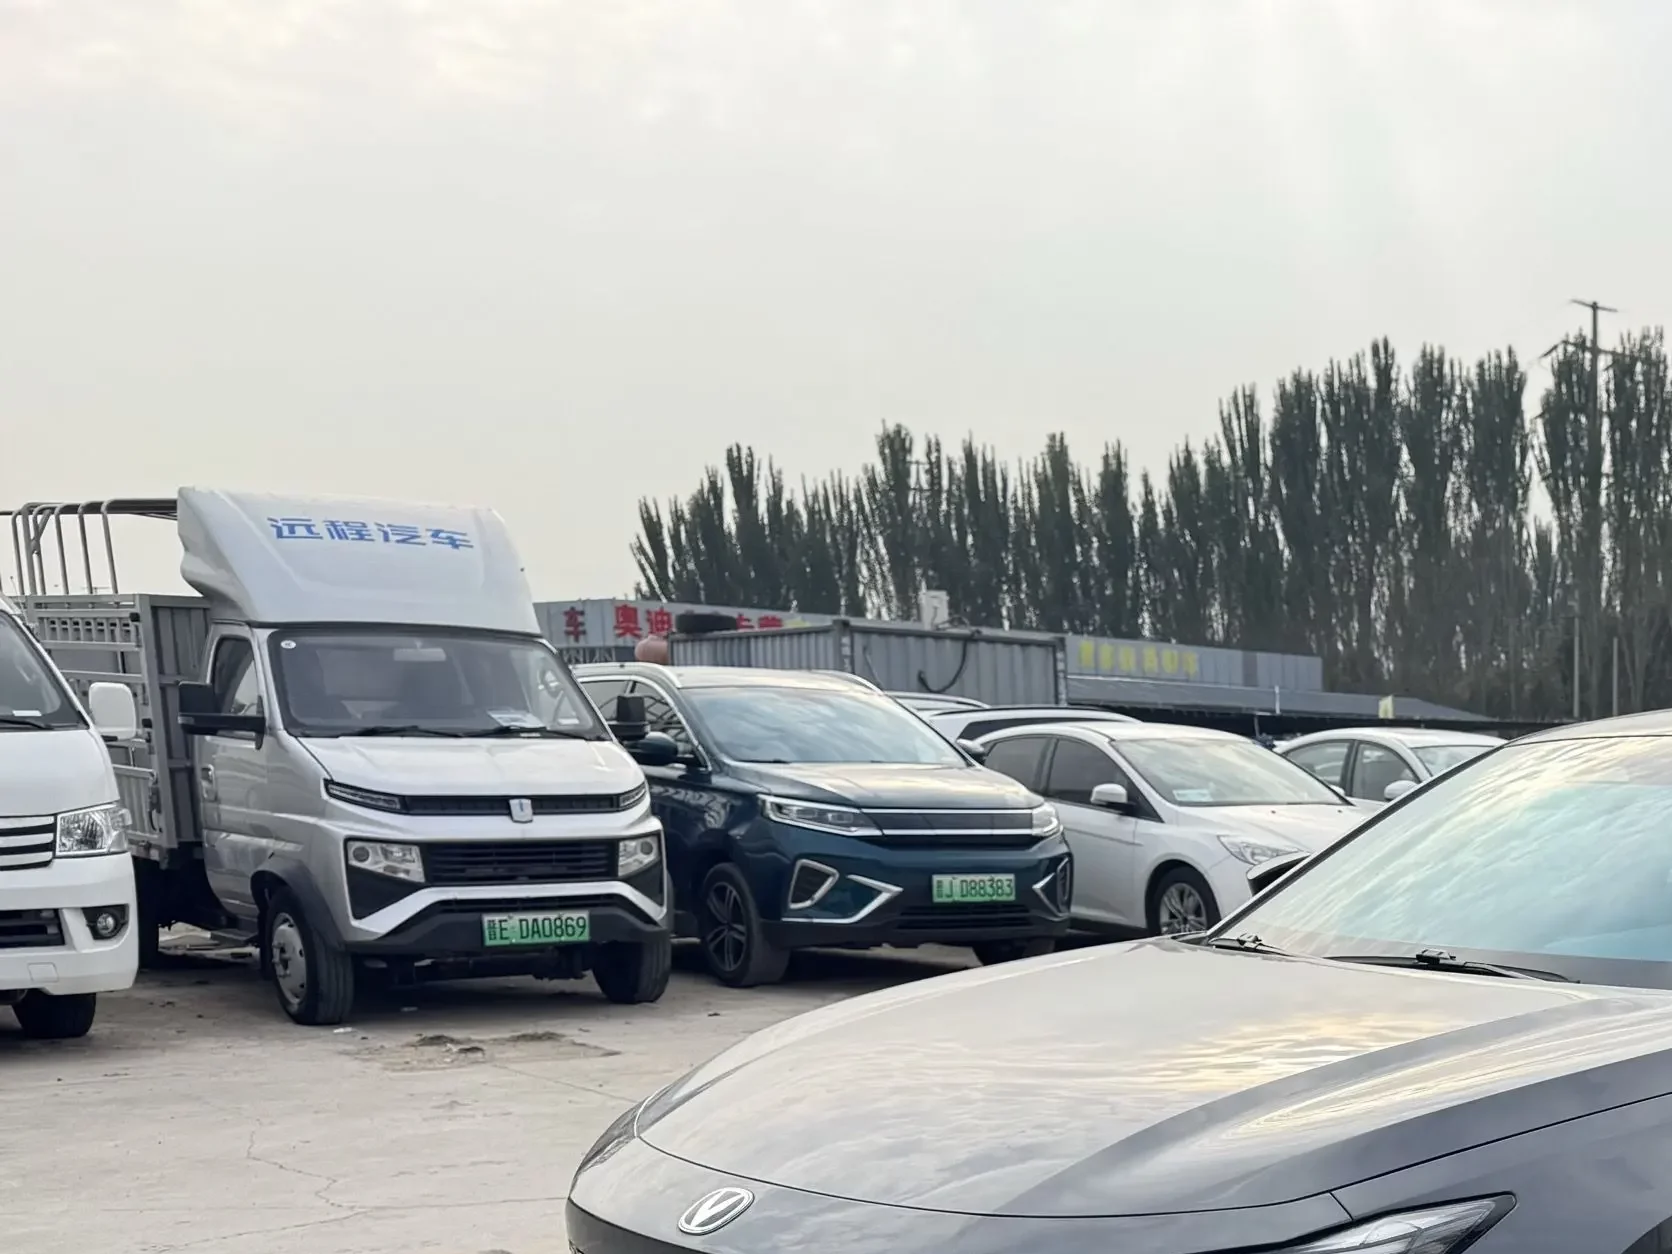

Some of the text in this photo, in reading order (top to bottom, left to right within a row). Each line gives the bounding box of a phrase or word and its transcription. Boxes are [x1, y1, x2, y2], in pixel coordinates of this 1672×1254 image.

[266, 517, 474, 550] 远程汽车
[563, 604, 673, 642] 车 奥迪
